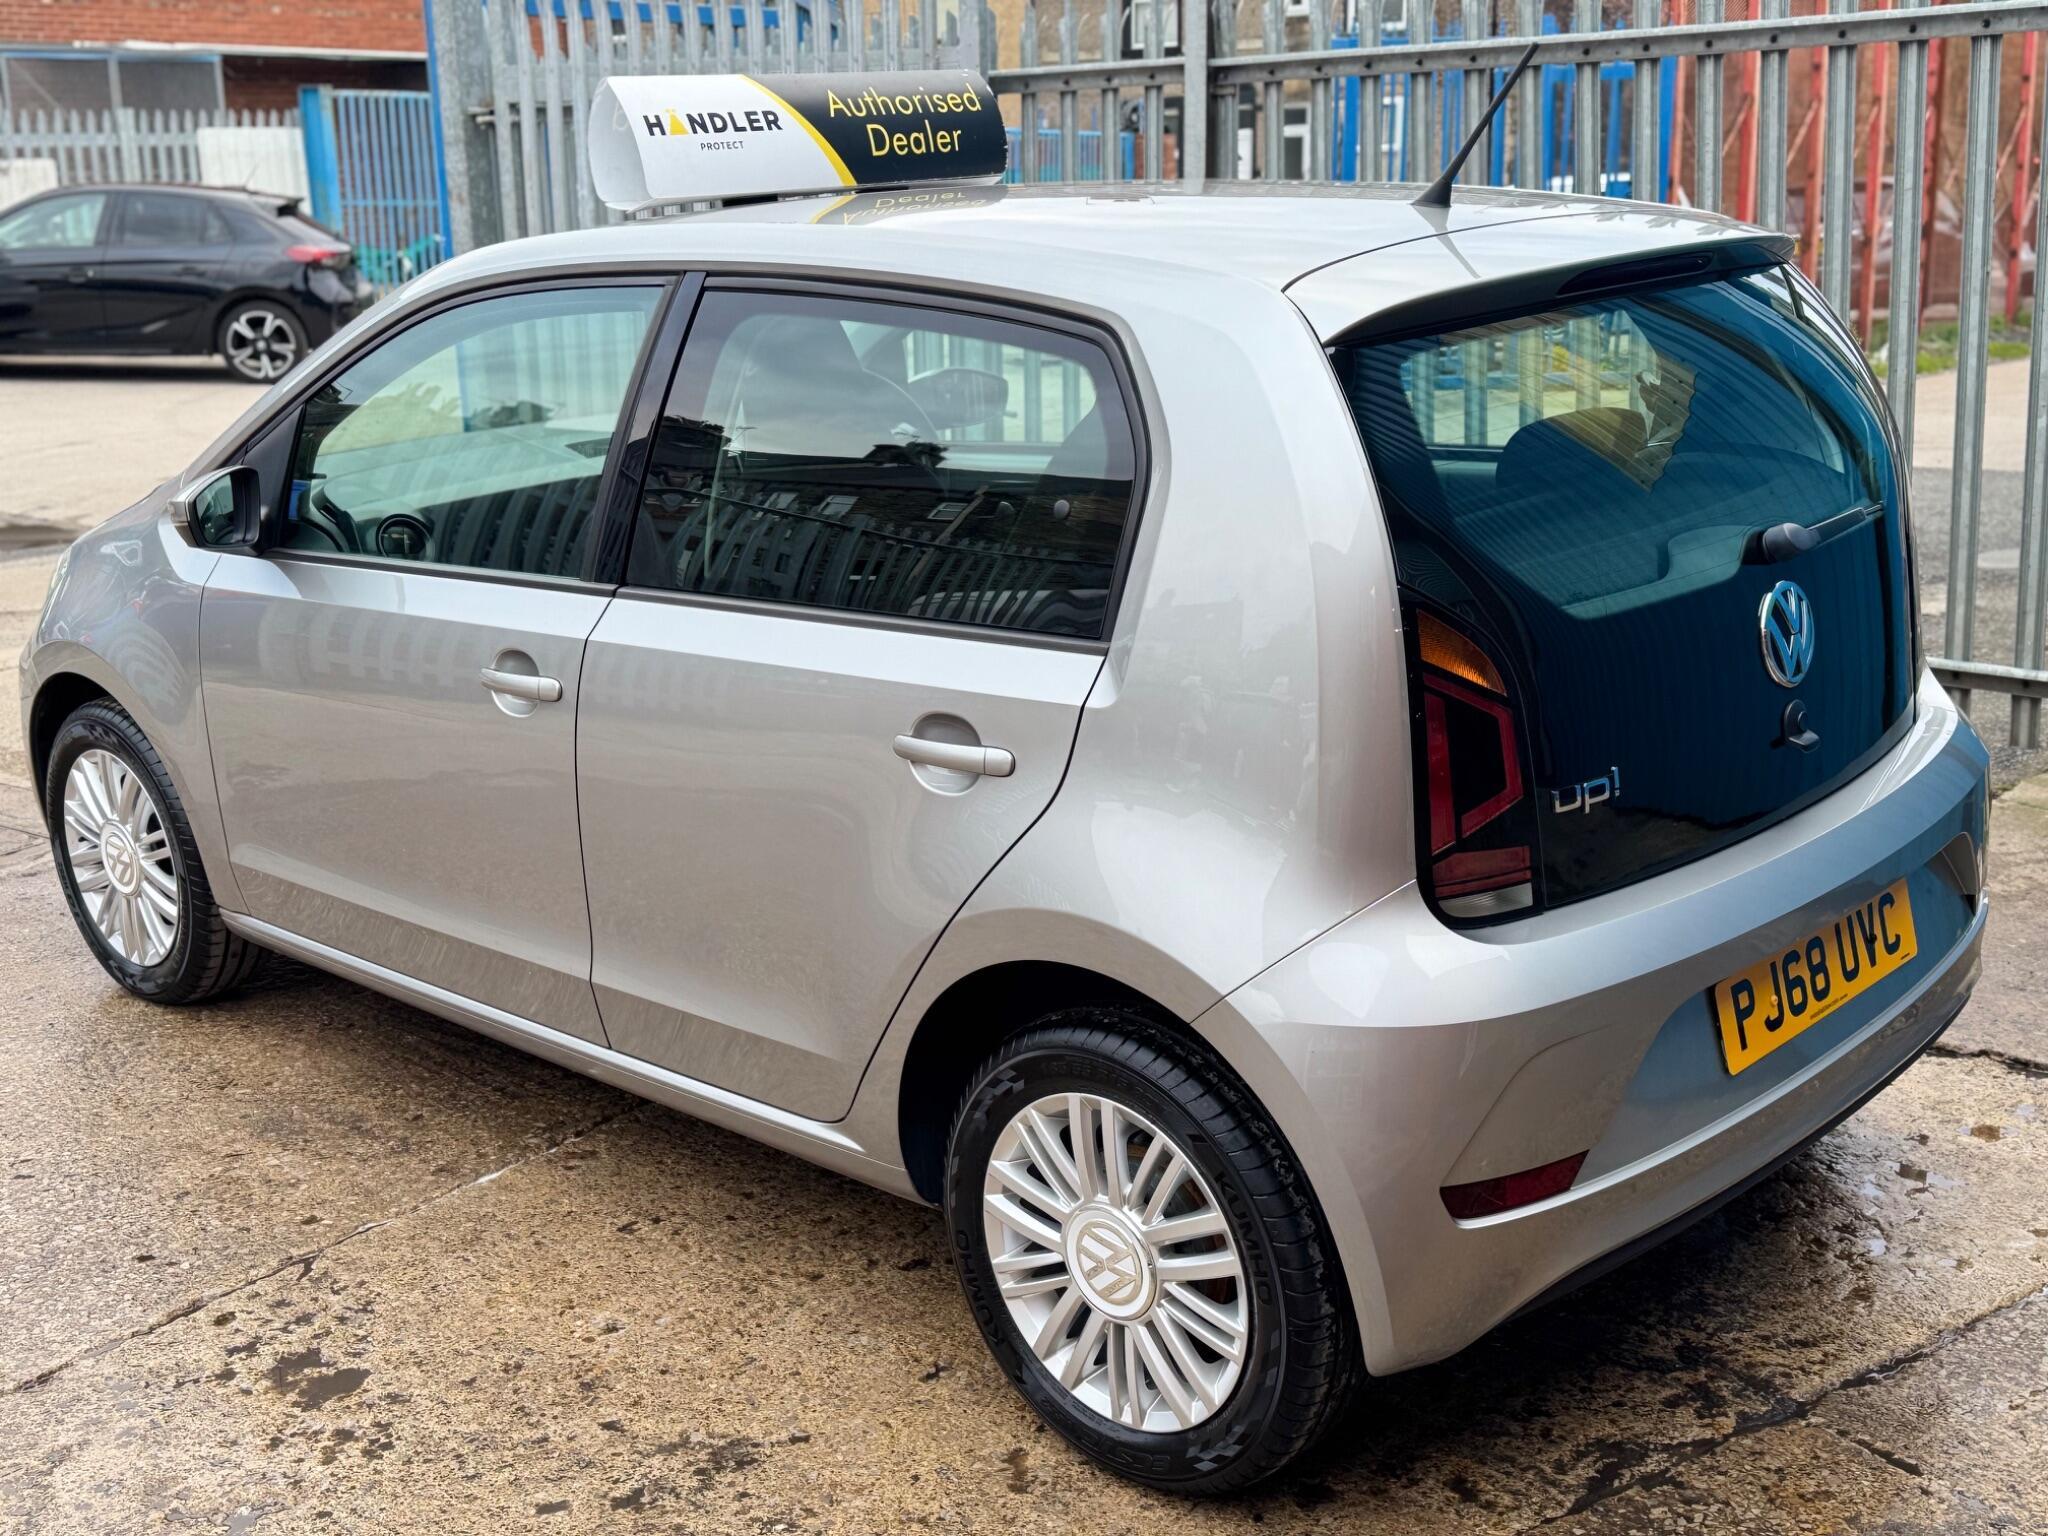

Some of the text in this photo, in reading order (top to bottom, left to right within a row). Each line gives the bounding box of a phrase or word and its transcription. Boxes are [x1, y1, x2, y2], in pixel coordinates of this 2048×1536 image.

[827, 82, 981, 118] Authorised
[700, 141, 744, 151] PROTECT
[866, 119, 961, 157] Dealer
[1551, 766, 1620, 814] up!
[1730, 892, 1901, 1051] PJ68 UVC
[1213, 1171, 1274, 1306] KUMHO
